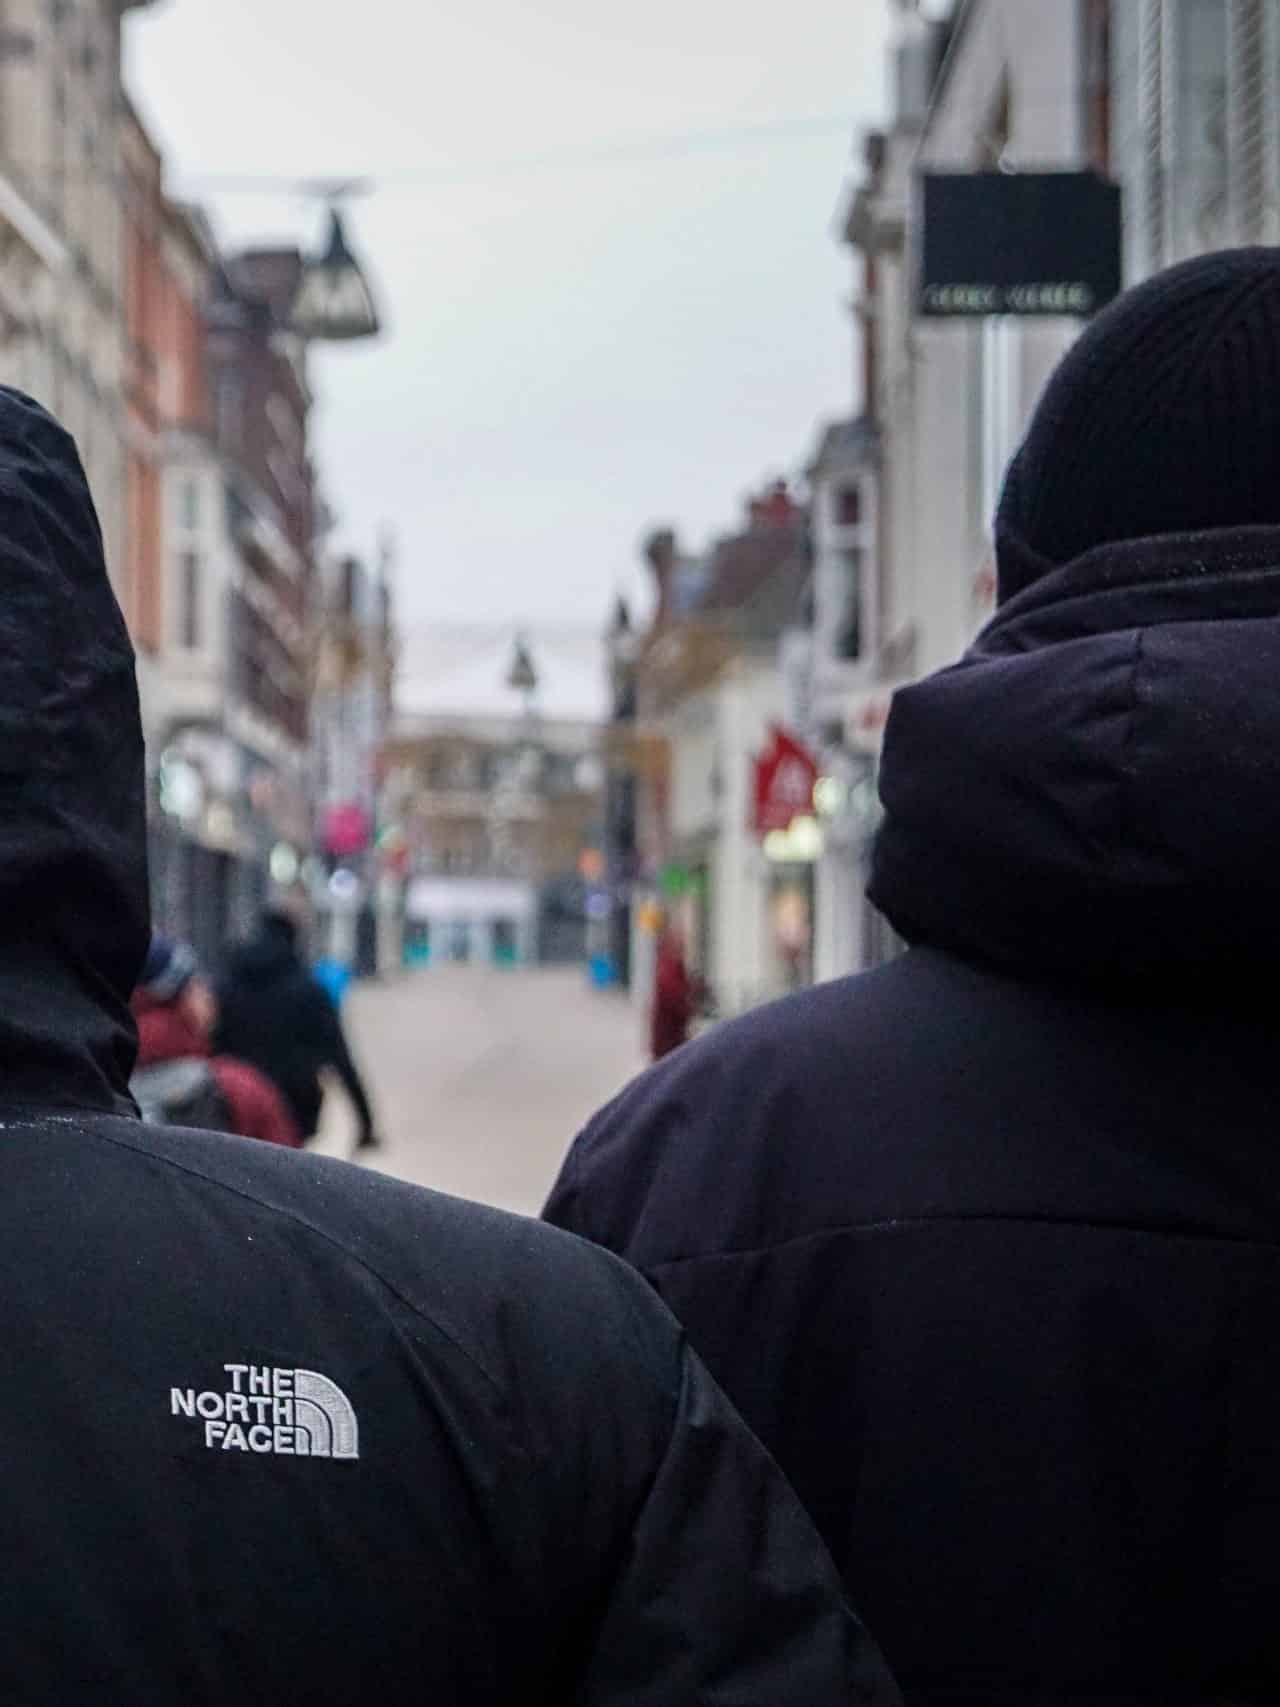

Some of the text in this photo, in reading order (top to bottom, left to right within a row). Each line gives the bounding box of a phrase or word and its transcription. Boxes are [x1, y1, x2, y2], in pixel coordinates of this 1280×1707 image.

[223, 1363, 295, 1398] THE
[170, 1387, 294, 1426] NORTH
[204, 1420, 295, 1455] FACE
